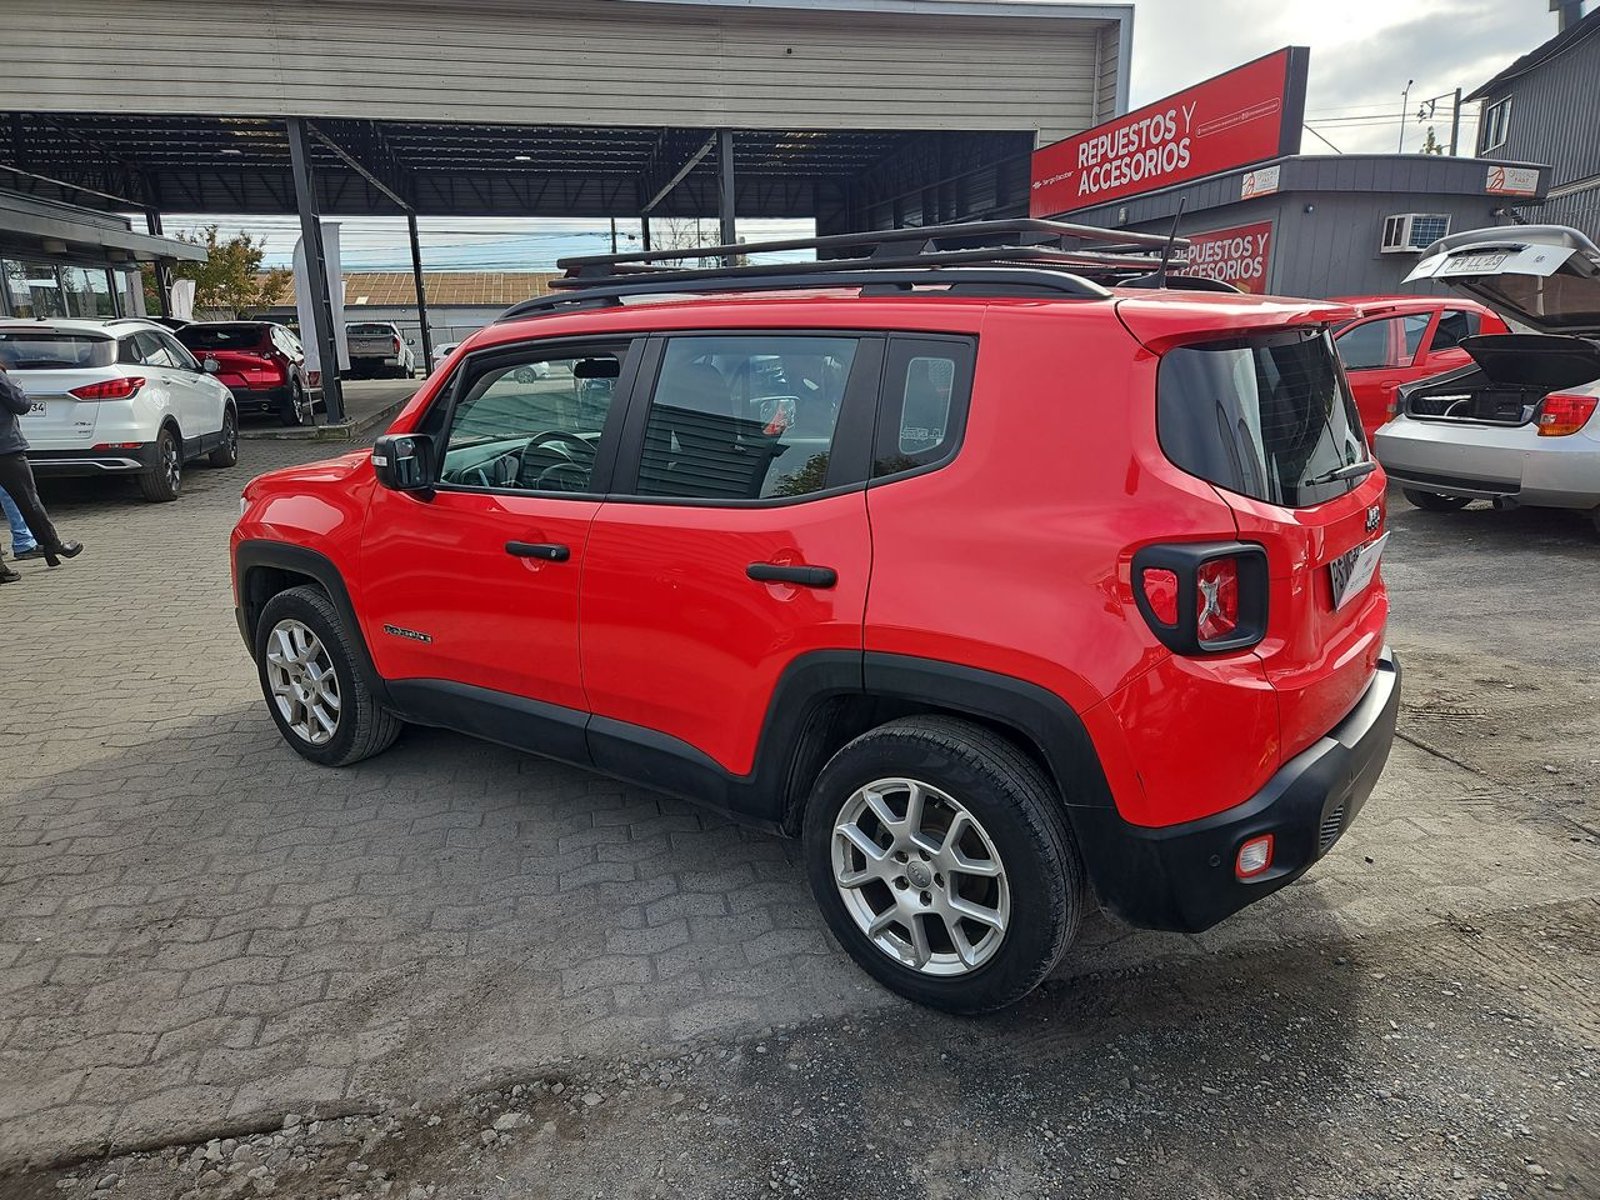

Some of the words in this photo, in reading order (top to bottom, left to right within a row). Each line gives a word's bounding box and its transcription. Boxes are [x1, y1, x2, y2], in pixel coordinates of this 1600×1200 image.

[1078, 109, 1177, 169] REPUESTOS
[1182, 101, 1197, 134] Y
[1078, 137, 1191, 196] ACCESORIOS
[1257, 233, 1269, 254] Y
